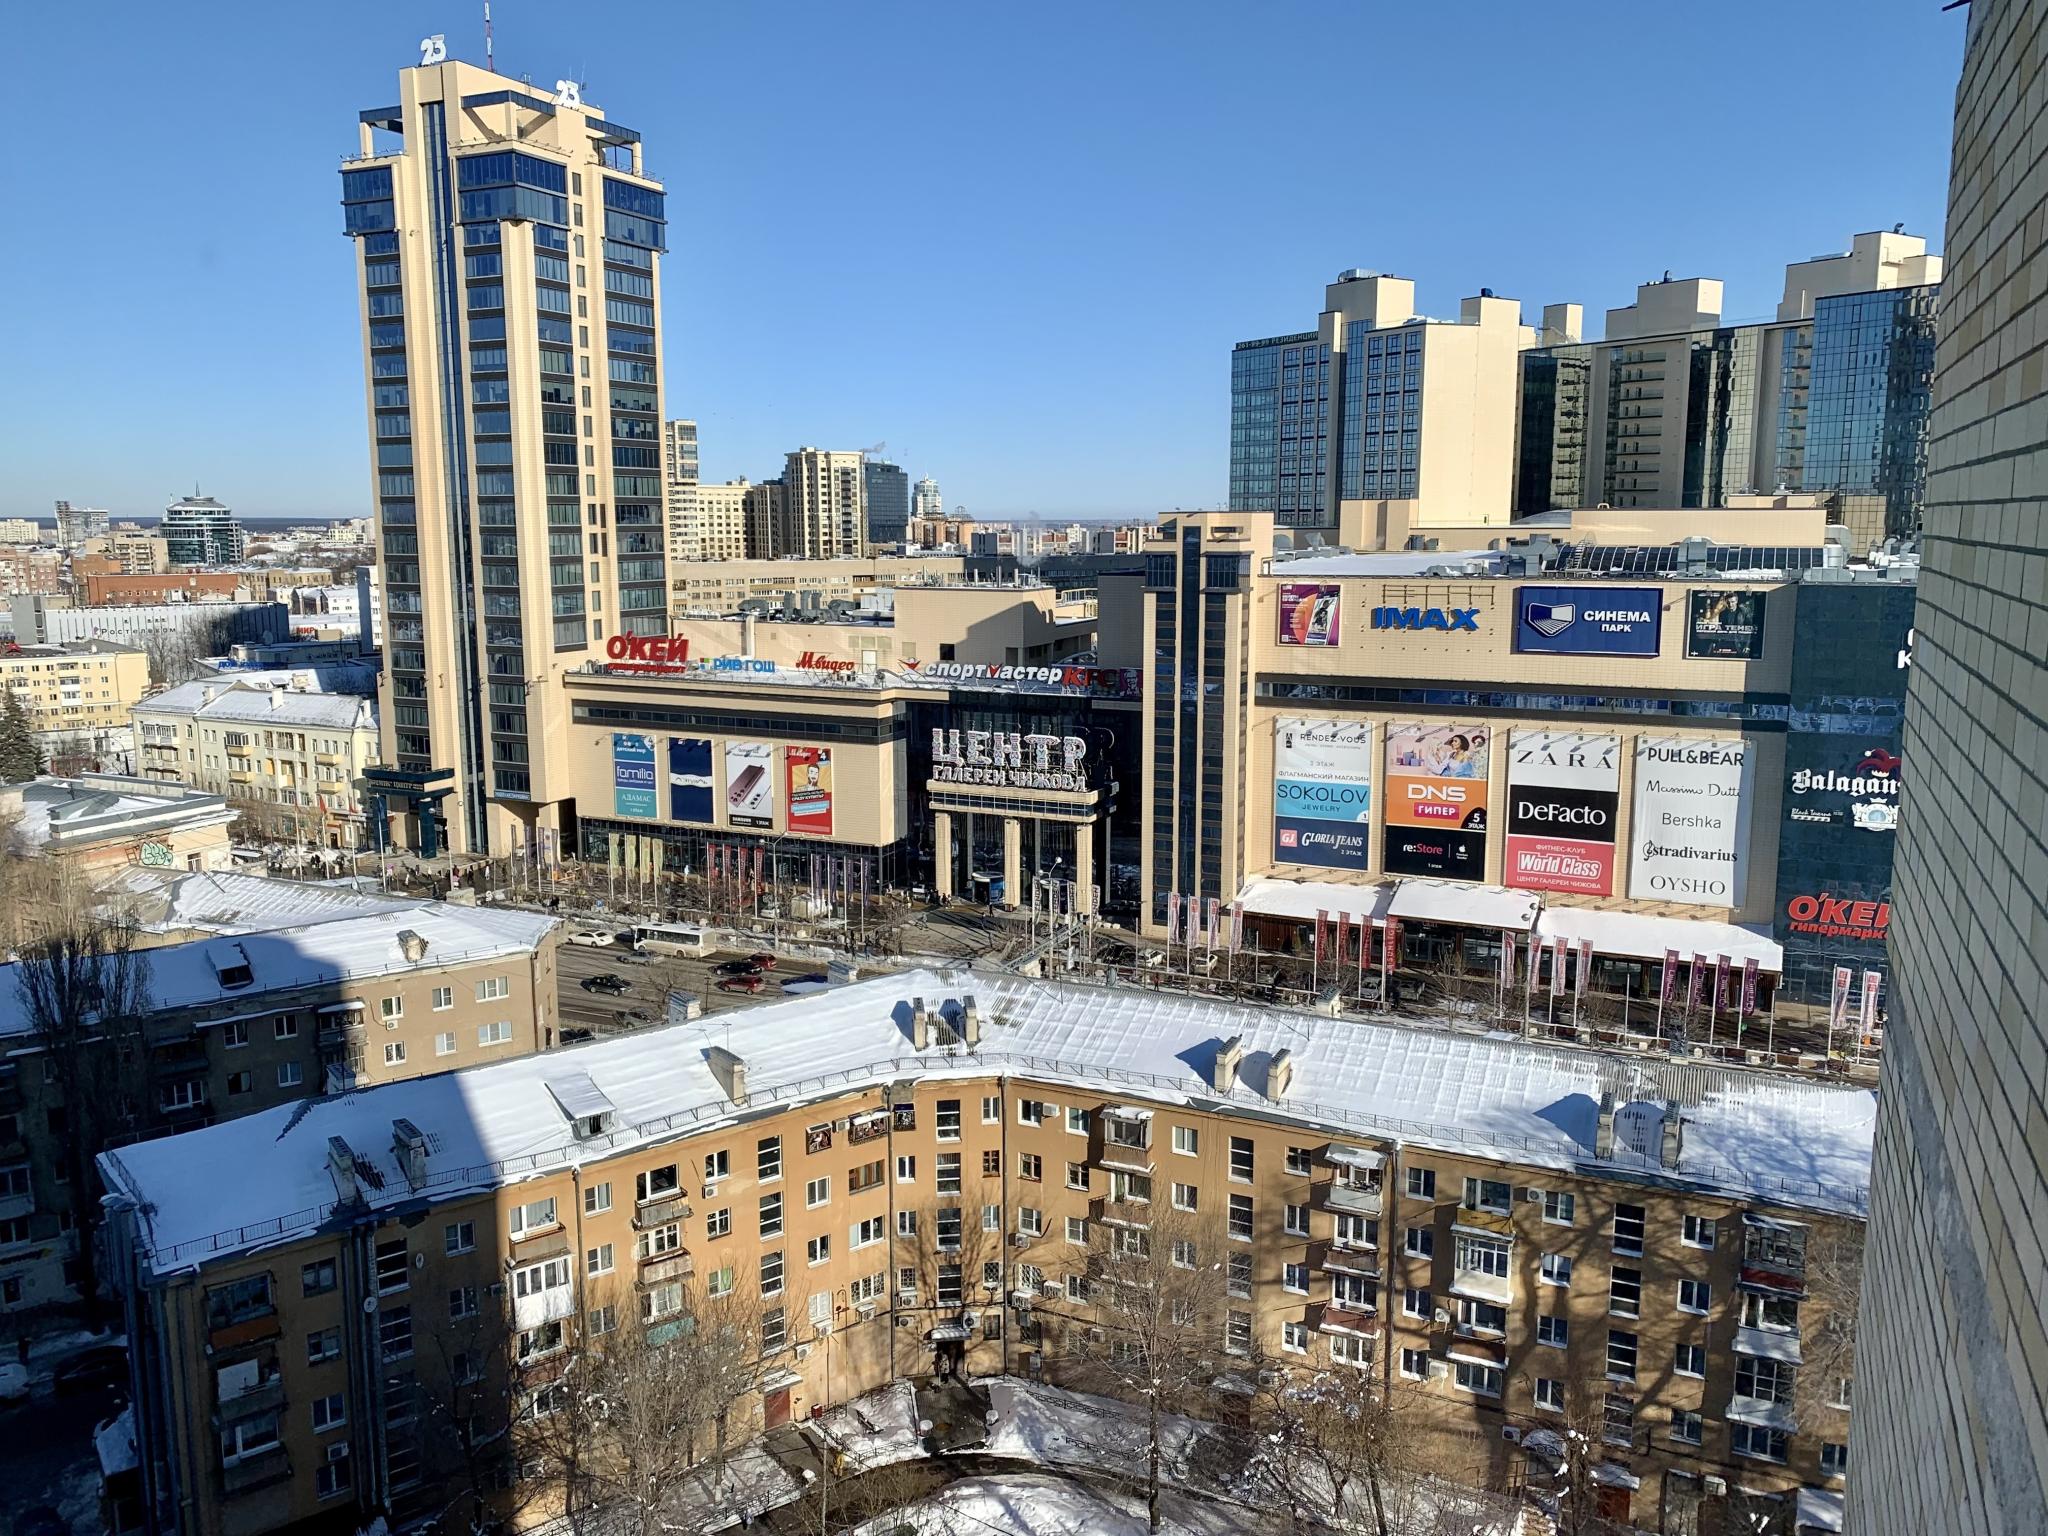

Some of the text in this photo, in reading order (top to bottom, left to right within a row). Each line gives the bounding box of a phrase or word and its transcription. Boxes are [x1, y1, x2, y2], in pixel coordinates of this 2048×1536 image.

[1372, 606, 1480, 631] IMAX
[1583, 610, 1651, 623] СИНЕМА
[101, 626, 176, 635] Ростелеком
[1601, 623, 1632, 633] ПАРК
[1062, 666, 1118, 688] KFC
[1300, 733, 1366, 744] RENDEZ-VOUS
[932, 727, 1087, 772] ЦЕНТР
[1517, 750, 1615, 769] ZARA
[1647, 747, 1744, 767] PULL&BEAR
[617, 765, 654, 780] familia
[1278, 770, 1369, 782] ФЛАГМАНСКИЙ МАГАЗИН
[1277, 784, 1368, 804] SOKOLOV
[1407, 783, 1466, 802] DNS
[1645, 780, 1704, 795] Massimo
[621, 793, 652, 802] АДАМАС
[1302, 804, 1341, 812] JEWELRY
[1418, 805, 1456, 816] ГИПЕР
[1518, 801, 1607, 826] DeFacto
[1472, 813, 1481, 822] 5
[1662, 812, 1722, 829] Bershka
[1467, 822, 1485, 830] ЭТАЖ
[1402, 843, 1443, 855] re:Store
[1535, 844, 1587, 854] ФИТНЕС-КЛУБ
[1520, 853, 1599, 877] World Class
[1539, 878, 1569, 886] ГАЛЕРЕИ
[1570, 880, 1601, 889] ЧИЖОВА
[1650, 875, 1726, 895] OYSHO
